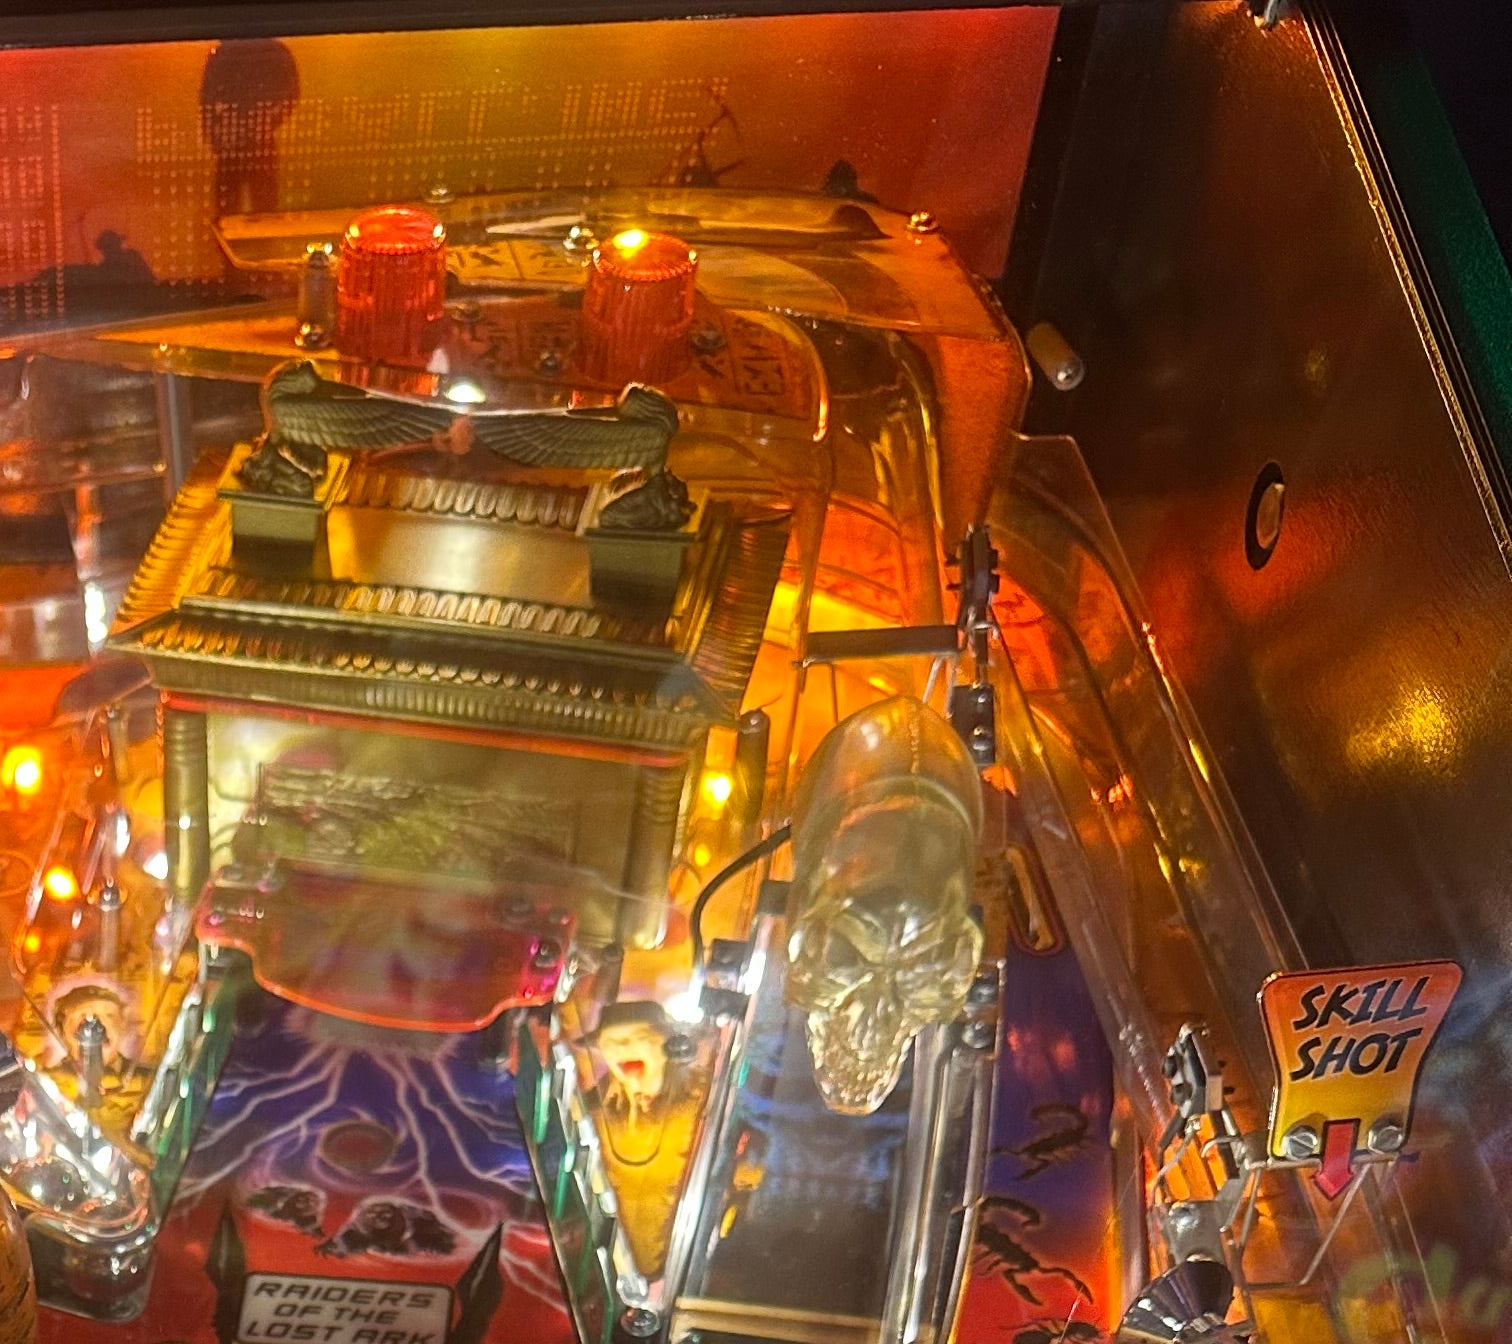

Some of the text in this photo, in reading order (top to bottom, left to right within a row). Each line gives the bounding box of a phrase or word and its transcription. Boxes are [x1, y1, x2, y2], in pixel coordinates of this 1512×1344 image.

[1291, 976, 1431, 1031] SKILL
[1288, 1027, 1424, 1083] SHOT
[254, 1281, 436, 1310] RAIDERS
[274, 1303, 401, 1326] OF THE
[245, 1321, 344, 1342] LOST
